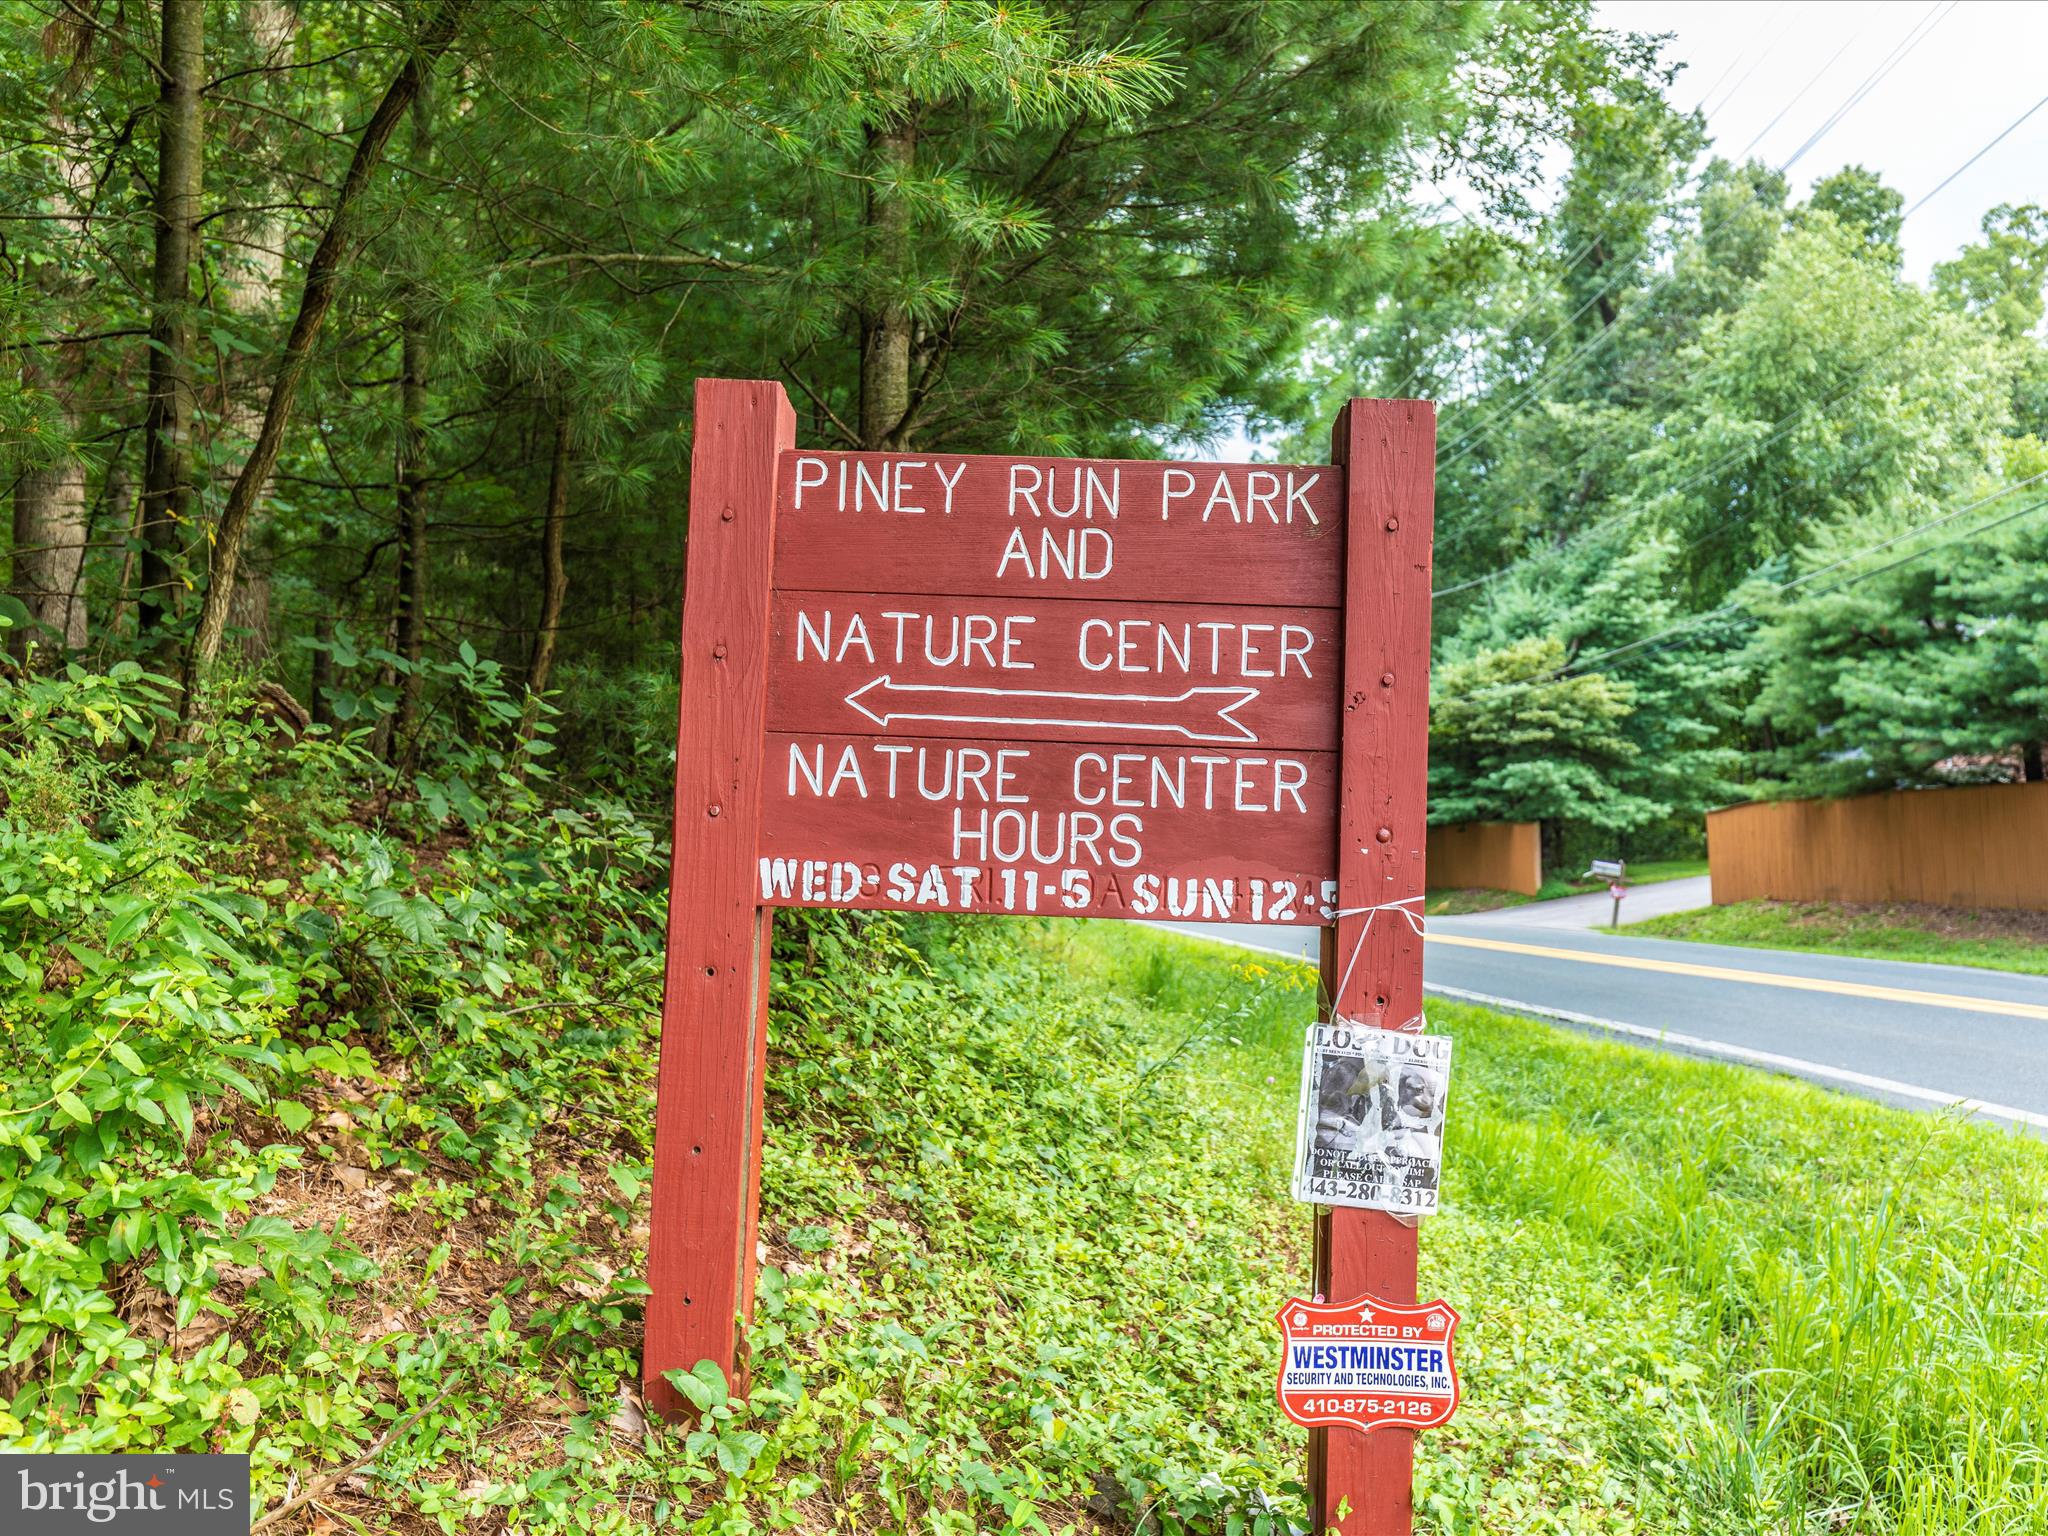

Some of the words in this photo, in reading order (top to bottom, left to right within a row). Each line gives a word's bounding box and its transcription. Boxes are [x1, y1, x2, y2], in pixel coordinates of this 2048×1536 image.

[795, 457, 966, 514] PINEY
[1008, 464, 1120, 519] RUN
[1161, 468, 1320, 526] PARK
[997, 527, 1114, 580] AND
[797, 610, 1036, 669] NATURE
[1078, 618, 1314, 679] CENTER
[788, 743, 1030, 803] NATURE
[1073, 752, 1308, 813] CENTER
[952, 807, 1144, 867] HOURS
[1001, 868, 1091, 911] 11-5
[1130, 874, 1234, 918] SUN
[1315, 1028, 1386, 1054] LO
[1311, 1148, 1324, 1157] DO
[1325, 1149, 1347, 1160] NOT
[1384, 1155, 1434, 1168] PPROAC
[1320, 1158, 1333, 1168] OR
[1336, 1160, 1360, 1170] CALL
[1364, 1162, 1384, 1173] OUT
[1323, 1169, 1362, 1181] PLEASE
[1303, 1178, 1435, 1208] 443-280-8312
[1312, 1324, 1397, 1337] PROTECTED
[1402, 1326, 1423, 1338] BY
[1293, 1345, 1443, 1373] WESTMINSTER
[1286, 1372, 1331, 1385] SECURITY
[1334, 1372, 1353, 1385] AND
[1355, 1373, 1429, 1390] TECHNOLOGIES,
[1431, 1376, 1450, 1389] INC.
[1303, 1398, 1432, 1416] 410-875-2126
